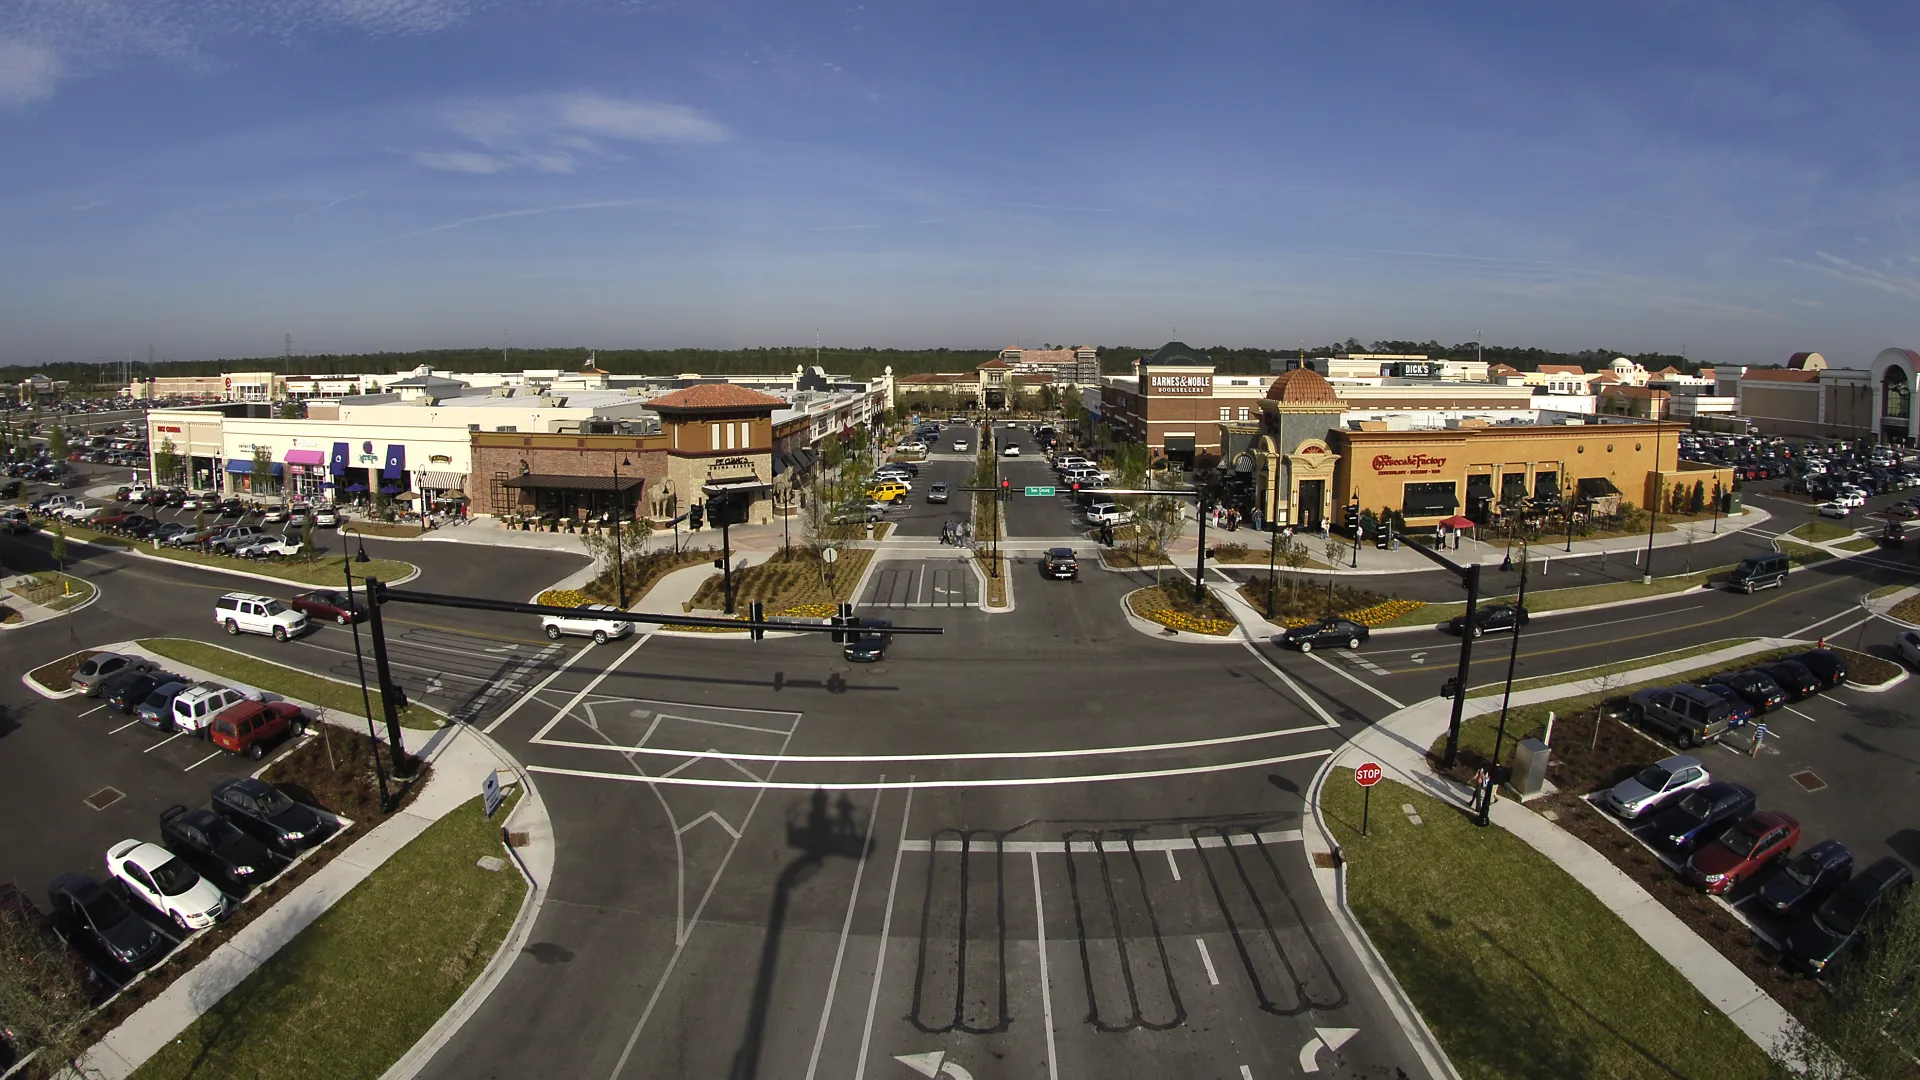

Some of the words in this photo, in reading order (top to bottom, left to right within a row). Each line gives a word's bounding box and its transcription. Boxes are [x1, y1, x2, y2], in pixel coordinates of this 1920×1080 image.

[1405, 365, 1429, 373] DICK'S
[1372, 455, 1417, 470] Cheesecake
[1413, 454, 1447, 469] Factory
[1357, 770, 1380, 780] STOP
